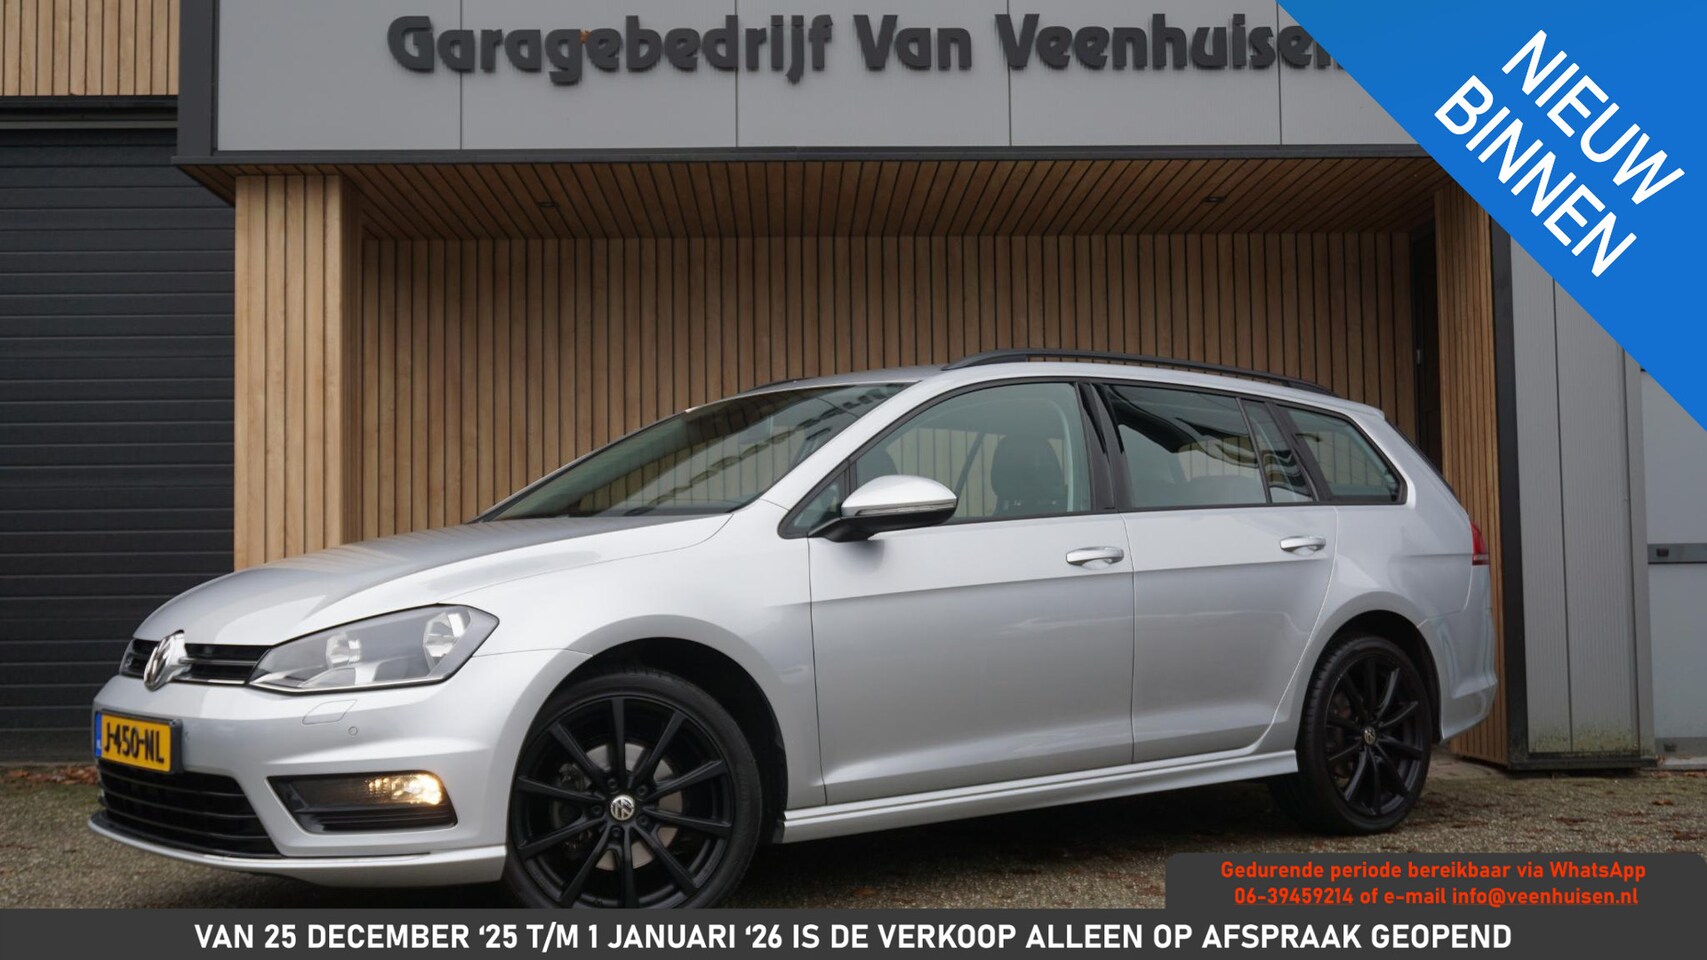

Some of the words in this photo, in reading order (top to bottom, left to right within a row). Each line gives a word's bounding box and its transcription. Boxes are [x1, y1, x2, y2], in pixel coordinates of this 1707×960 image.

[387, 15, 833, 84] Garagebedrijf
[854, 14, 972, 71] Van
[995, 13, 1344, 71] Veenhuise
[104, 722, 165, 765] J-450-NL
